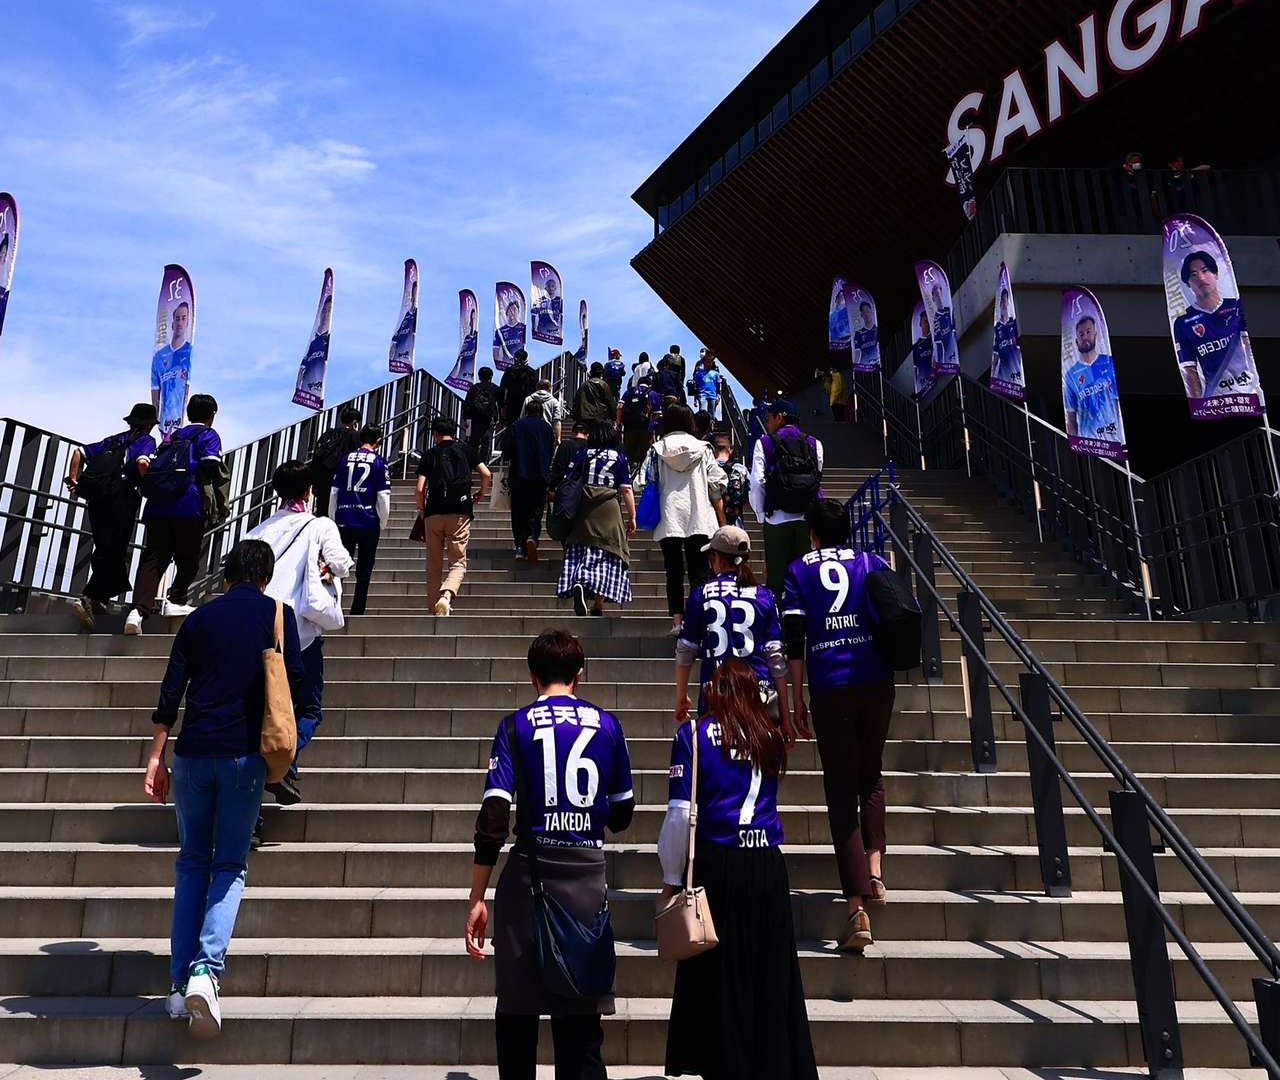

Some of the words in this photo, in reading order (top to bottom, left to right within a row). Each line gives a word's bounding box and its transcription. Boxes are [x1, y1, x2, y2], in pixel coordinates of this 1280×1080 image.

[346, 461, 371, 493] 12
[588, 456, 617, 488] 16
[802, 548, 856, 566] 任天堂
[702, 581, 758, 600] 任天堂
[819, 560, 850, 614] 9
[703, 599, 757, 658] 33
[825, 613, 860, 631] PATRIC
[526, 705, 602, 729] 任天堂
[532, 726, 600, 808] 16
[543, 812, 592, 832] TAKEDA
[738, 828, 770, 849] SOTA
